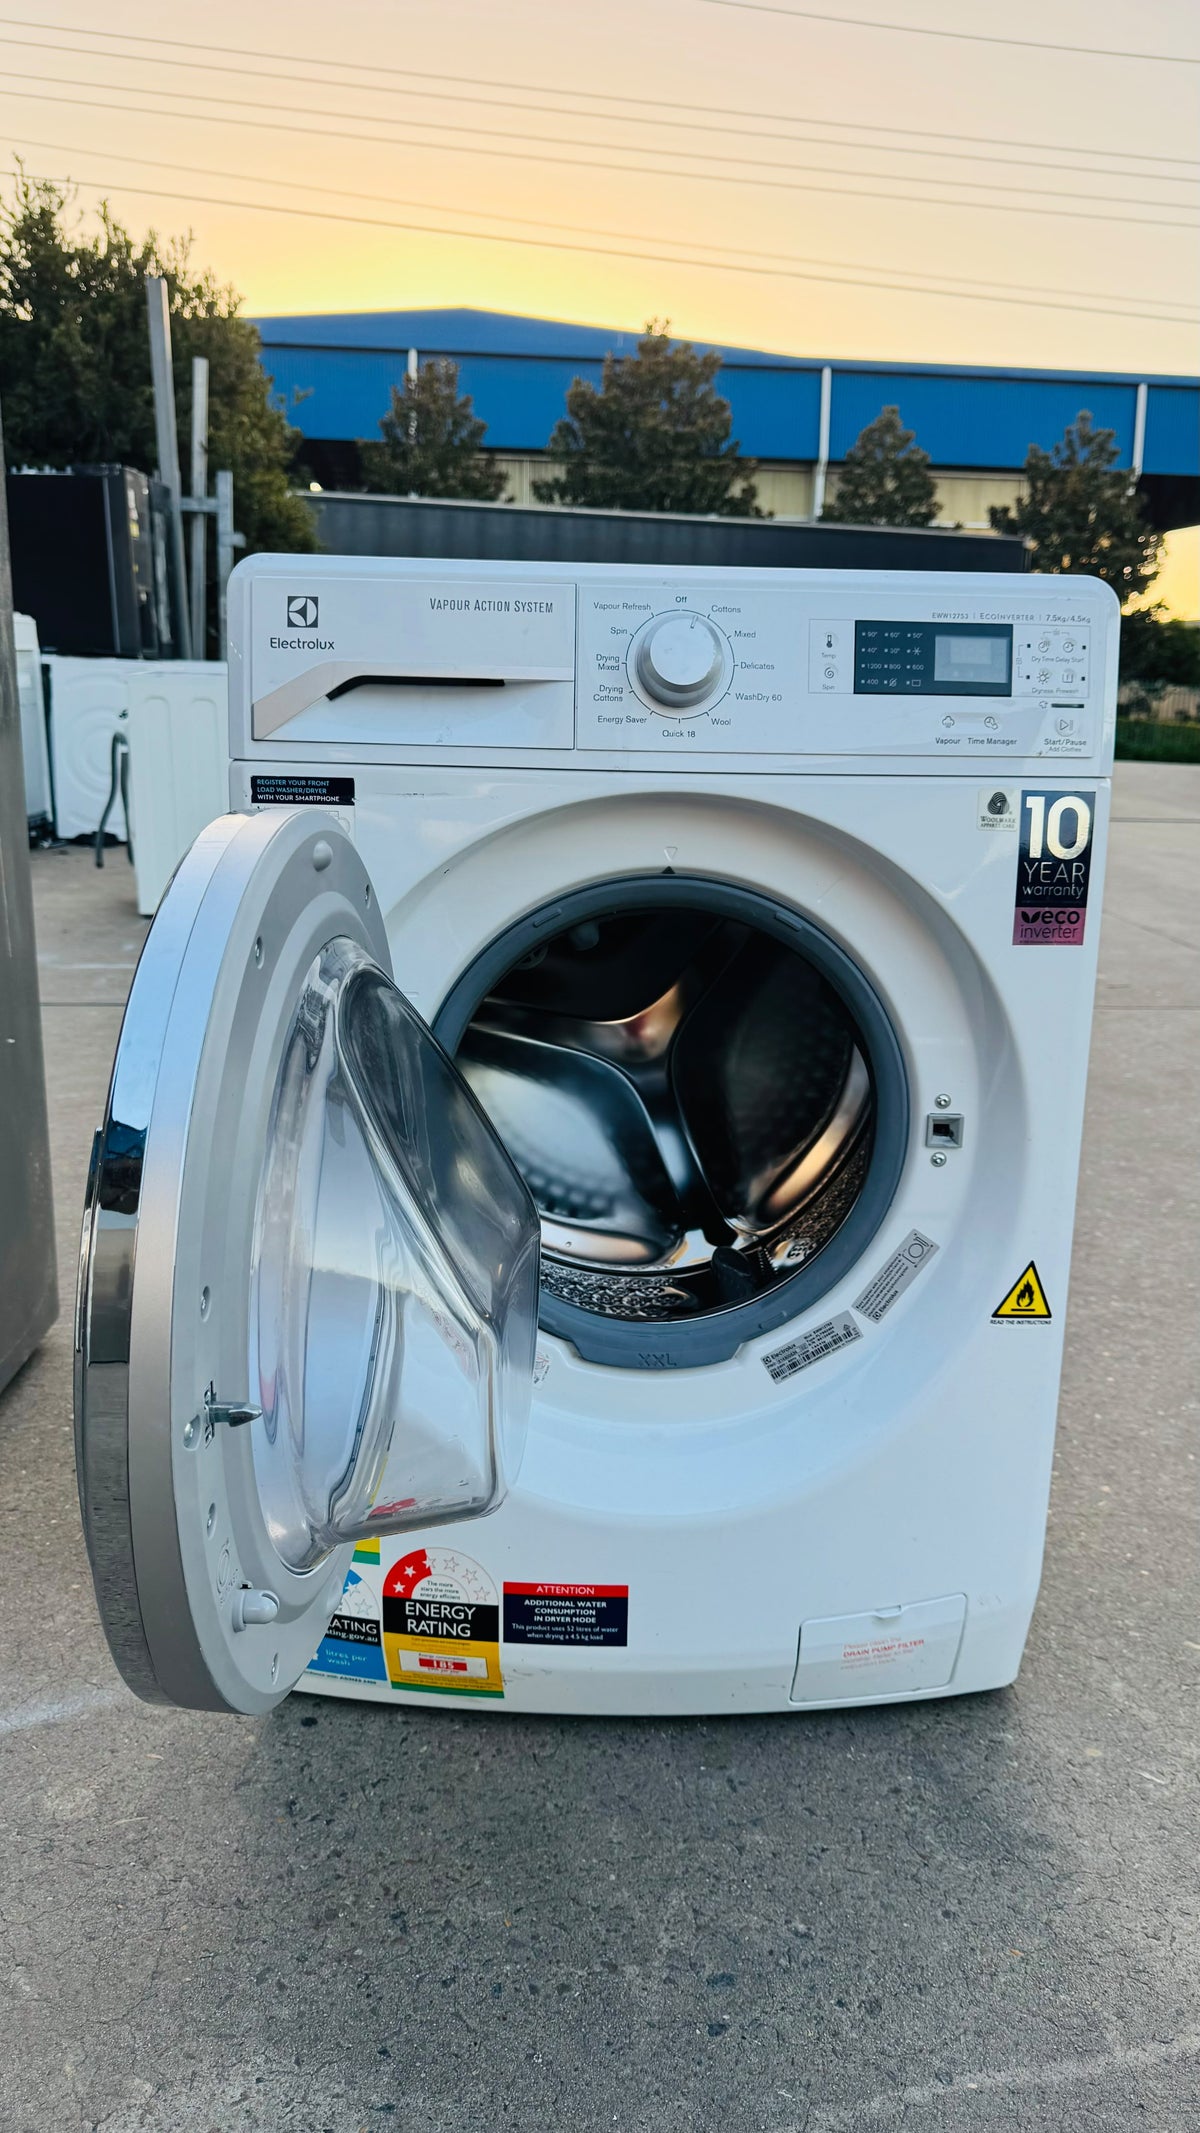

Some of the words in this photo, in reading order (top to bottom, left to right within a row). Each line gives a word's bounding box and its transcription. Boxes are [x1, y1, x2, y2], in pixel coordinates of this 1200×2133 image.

[675, 595, 688, 603] Off
[430, 598, 471, 612] VAPOUR
[474, 599, 511, 612] ACTION
[514, 600, 554, 613] SYSTEM
[593, 603, 620, 612] Vapour
[622, 603, 651, 611] Refresh
[711, 605, 741, 613] Cottons
[610, 627, 628, 636] Spin
[734, 630, 756, 638] Mixed
[269, 637, 335, 650] Electrolux
[596, 654, 620, 664] Drying
[597, 663, 620, 671] Mixed
[740, 661, 775, 670] Delicates
[599, 685, 623, 695] Drying
[593, 694, 623, 702] Cottons
[735, 693, 770, 703] WashDry
[772, 694, 782, 702] 60
[597, 716, 623, 725] Energy
[625, 716, 647, 724] Saver
[711, 718, 731, 726] Wool
[662, 730, 684, 738] Quick
[687, 730, 696, 738] 18
[986, 738, 1018, 746] Manager
[1044, 738, 1087, 746] Start/Pause
[1026, 796, 1091, 860] 10
[1024, 862, 1086, 884] YEAR
[1022, 884, 1084, 900] warranty
[1041, 911, 1080, 924] eco
[1020, 925, 1079, 938] inverter
[879, 1290, 899, 1313] Electrolux
[771, 1343, 796, 1360] Electrolux
[638, 1353, 677, 1367] XXL
[536, 1586, 595, 1595] ATTENTION
[524, 1599, 575, 1607] ADDITIONAL
[405, 1601, 477, 1620] ENERGY
[330, 1618, 377, 1634] ATING
[407, 1618, 471, 1637] RATING
[843, 1649, 870, 1658] DRAIN
[871, 1644, 896, 1653] PUMP
[898, 1639, 924, 1648] FILTER
[326, 1649, 349, 1658] litres
[352, 1654, 367, 1662] per
[328, 1658, 350, 1666] wash
